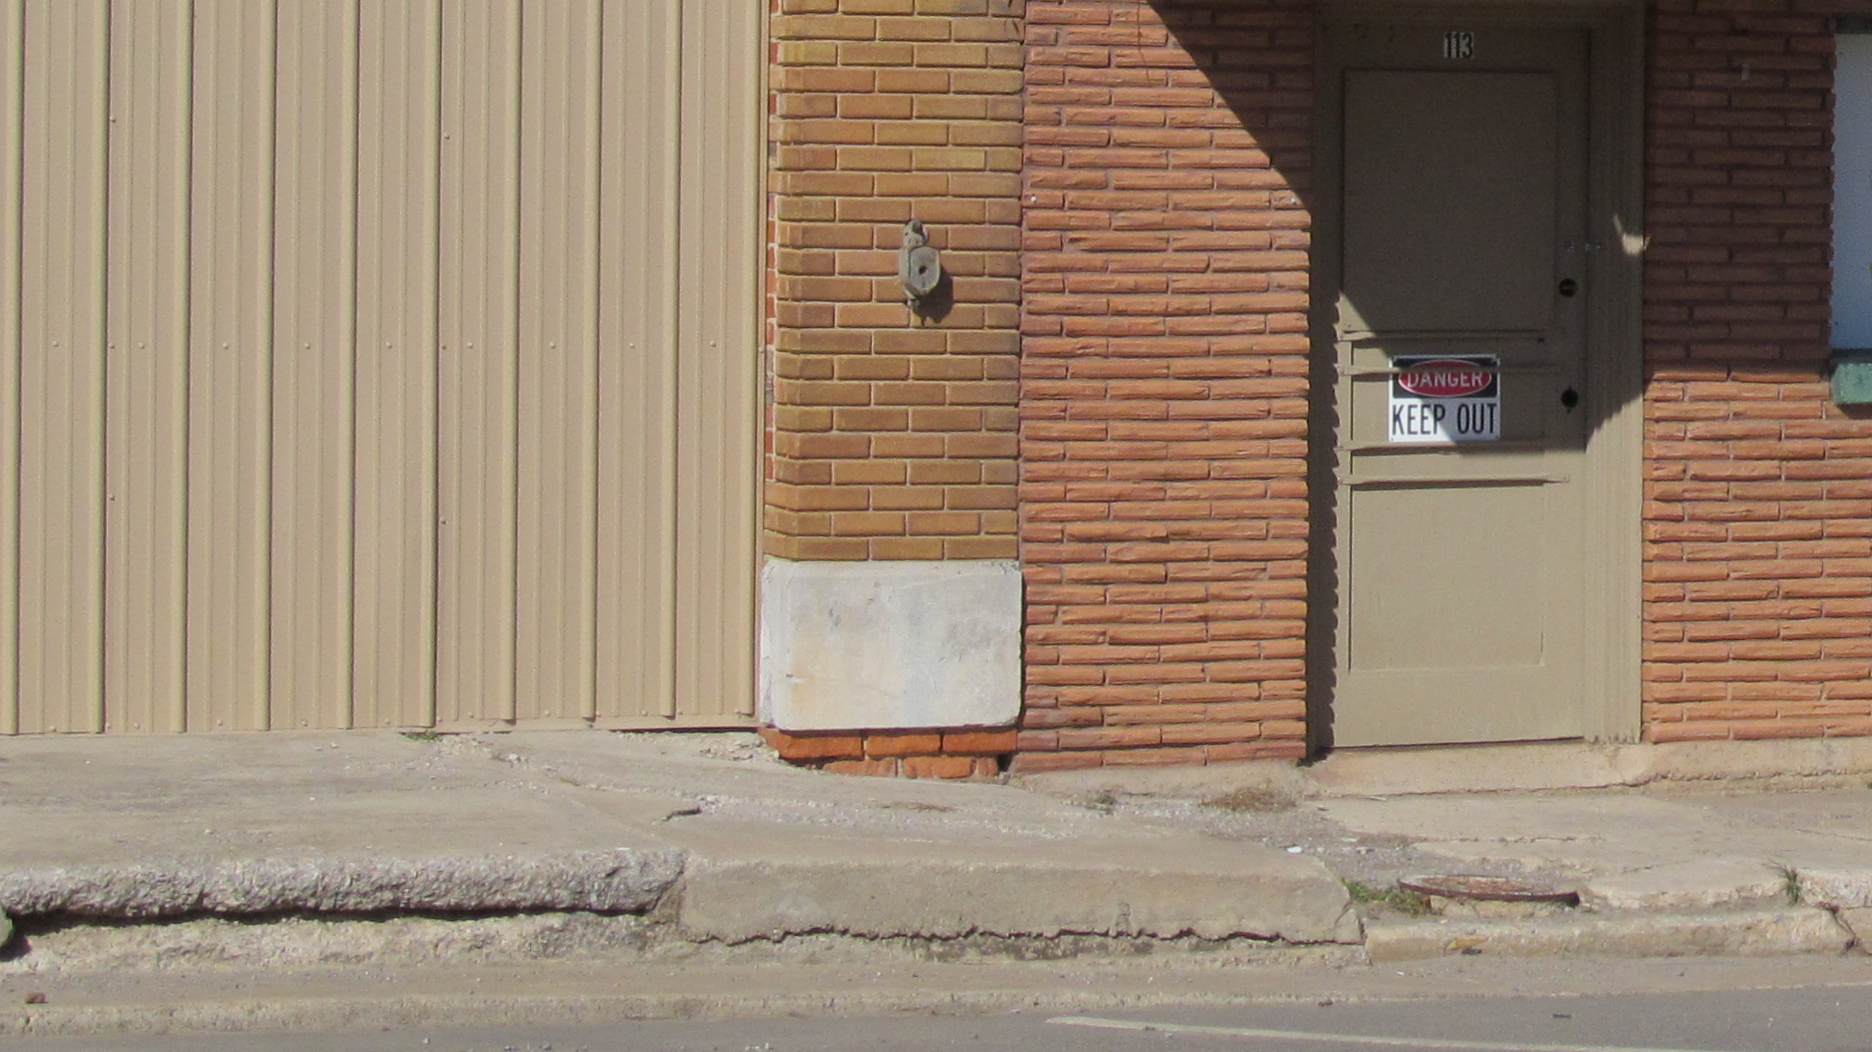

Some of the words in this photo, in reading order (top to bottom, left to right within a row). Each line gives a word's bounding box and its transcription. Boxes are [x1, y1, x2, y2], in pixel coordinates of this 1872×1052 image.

[1444, 32, 1473, 58] 113
[1407, 370, 1483, 387] DANGER
[1392, 404, 1446, 436] KEEP
[1457, 403, 1497, 435] OUT
